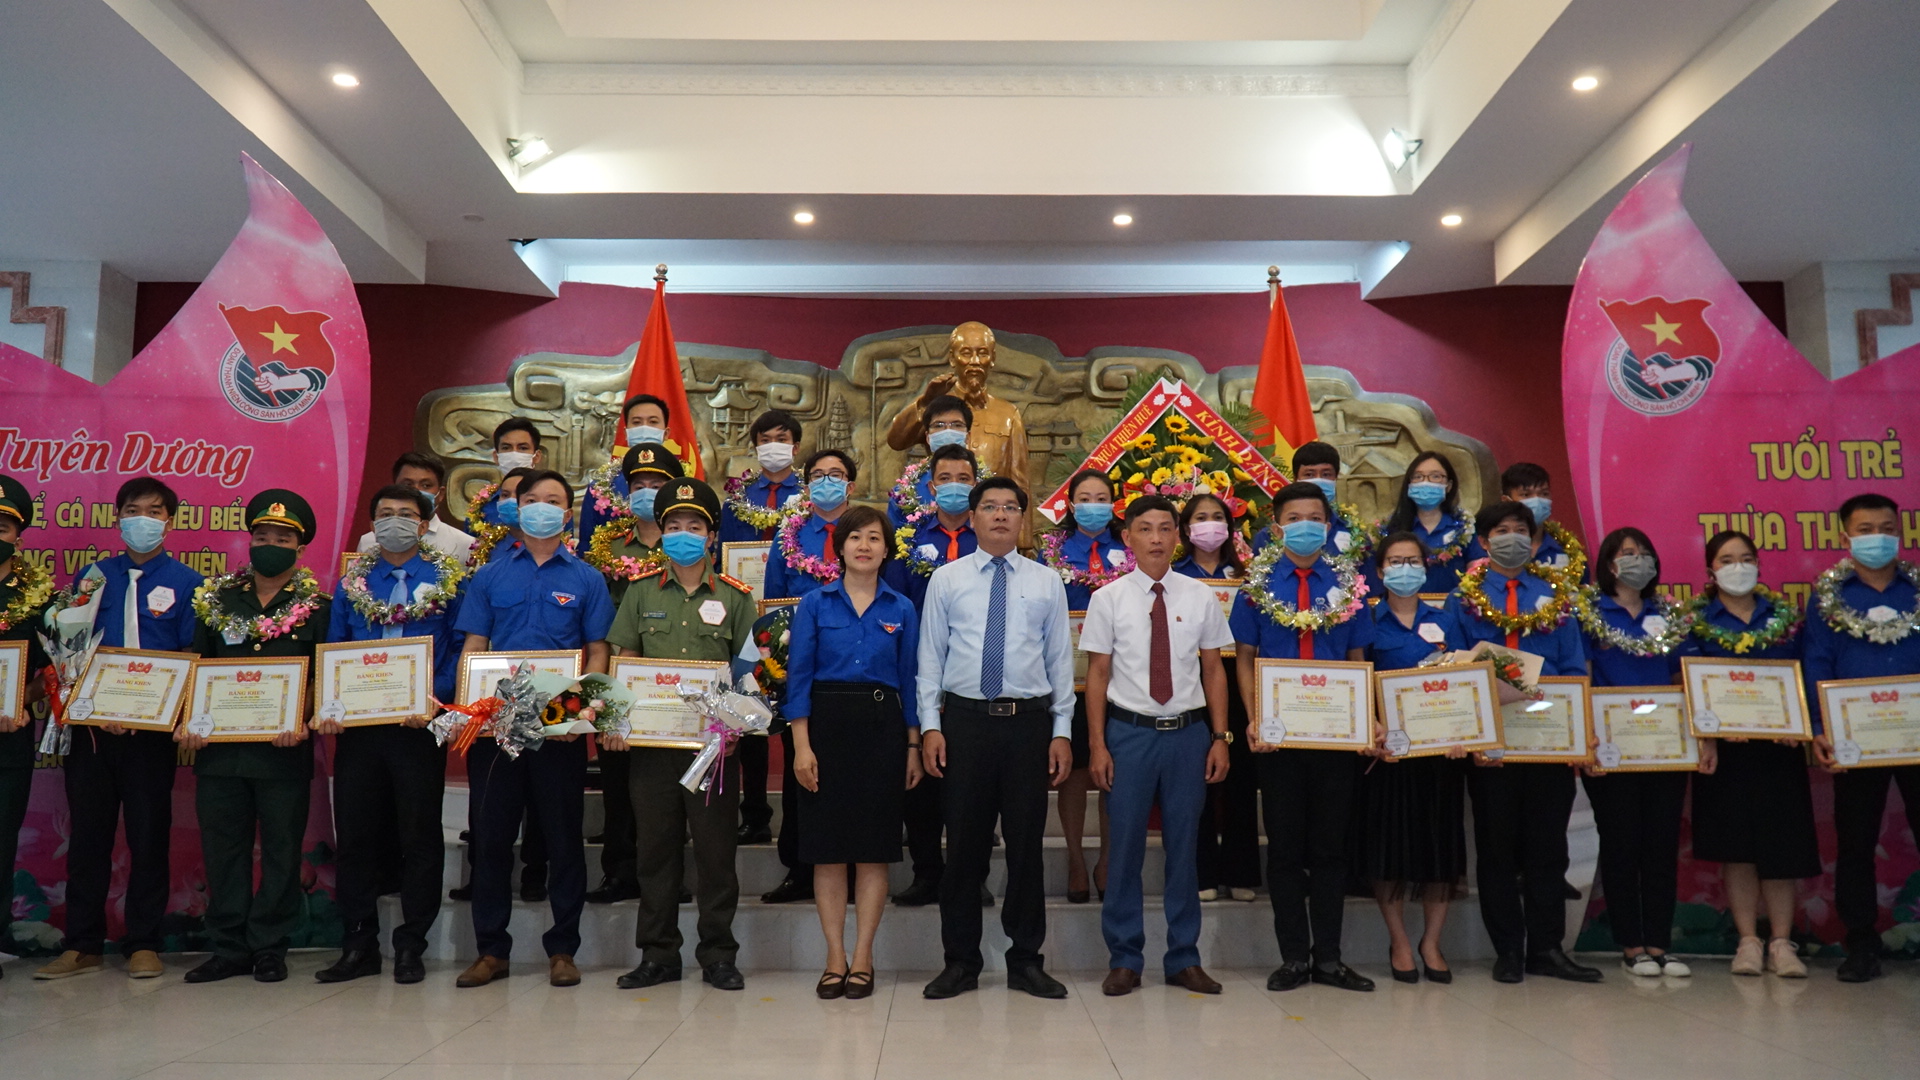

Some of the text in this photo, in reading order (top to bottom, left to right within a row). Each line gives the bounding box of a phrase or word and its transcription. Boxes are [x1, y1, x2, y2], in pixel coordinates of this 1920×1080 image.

[299, 393, 314, 411] MINH
[1112, 423, 1138, 448] THIÊN
[1134, 404, 1154, 427] HUẾ
[1195, 410, 1241, 448] KÍNH
[0, 427, 253, 489] Tuyên Dương
[1749, 425, 1904, 481] TUỔI TRẺ
[55, 497, 85, 528] CÁ
